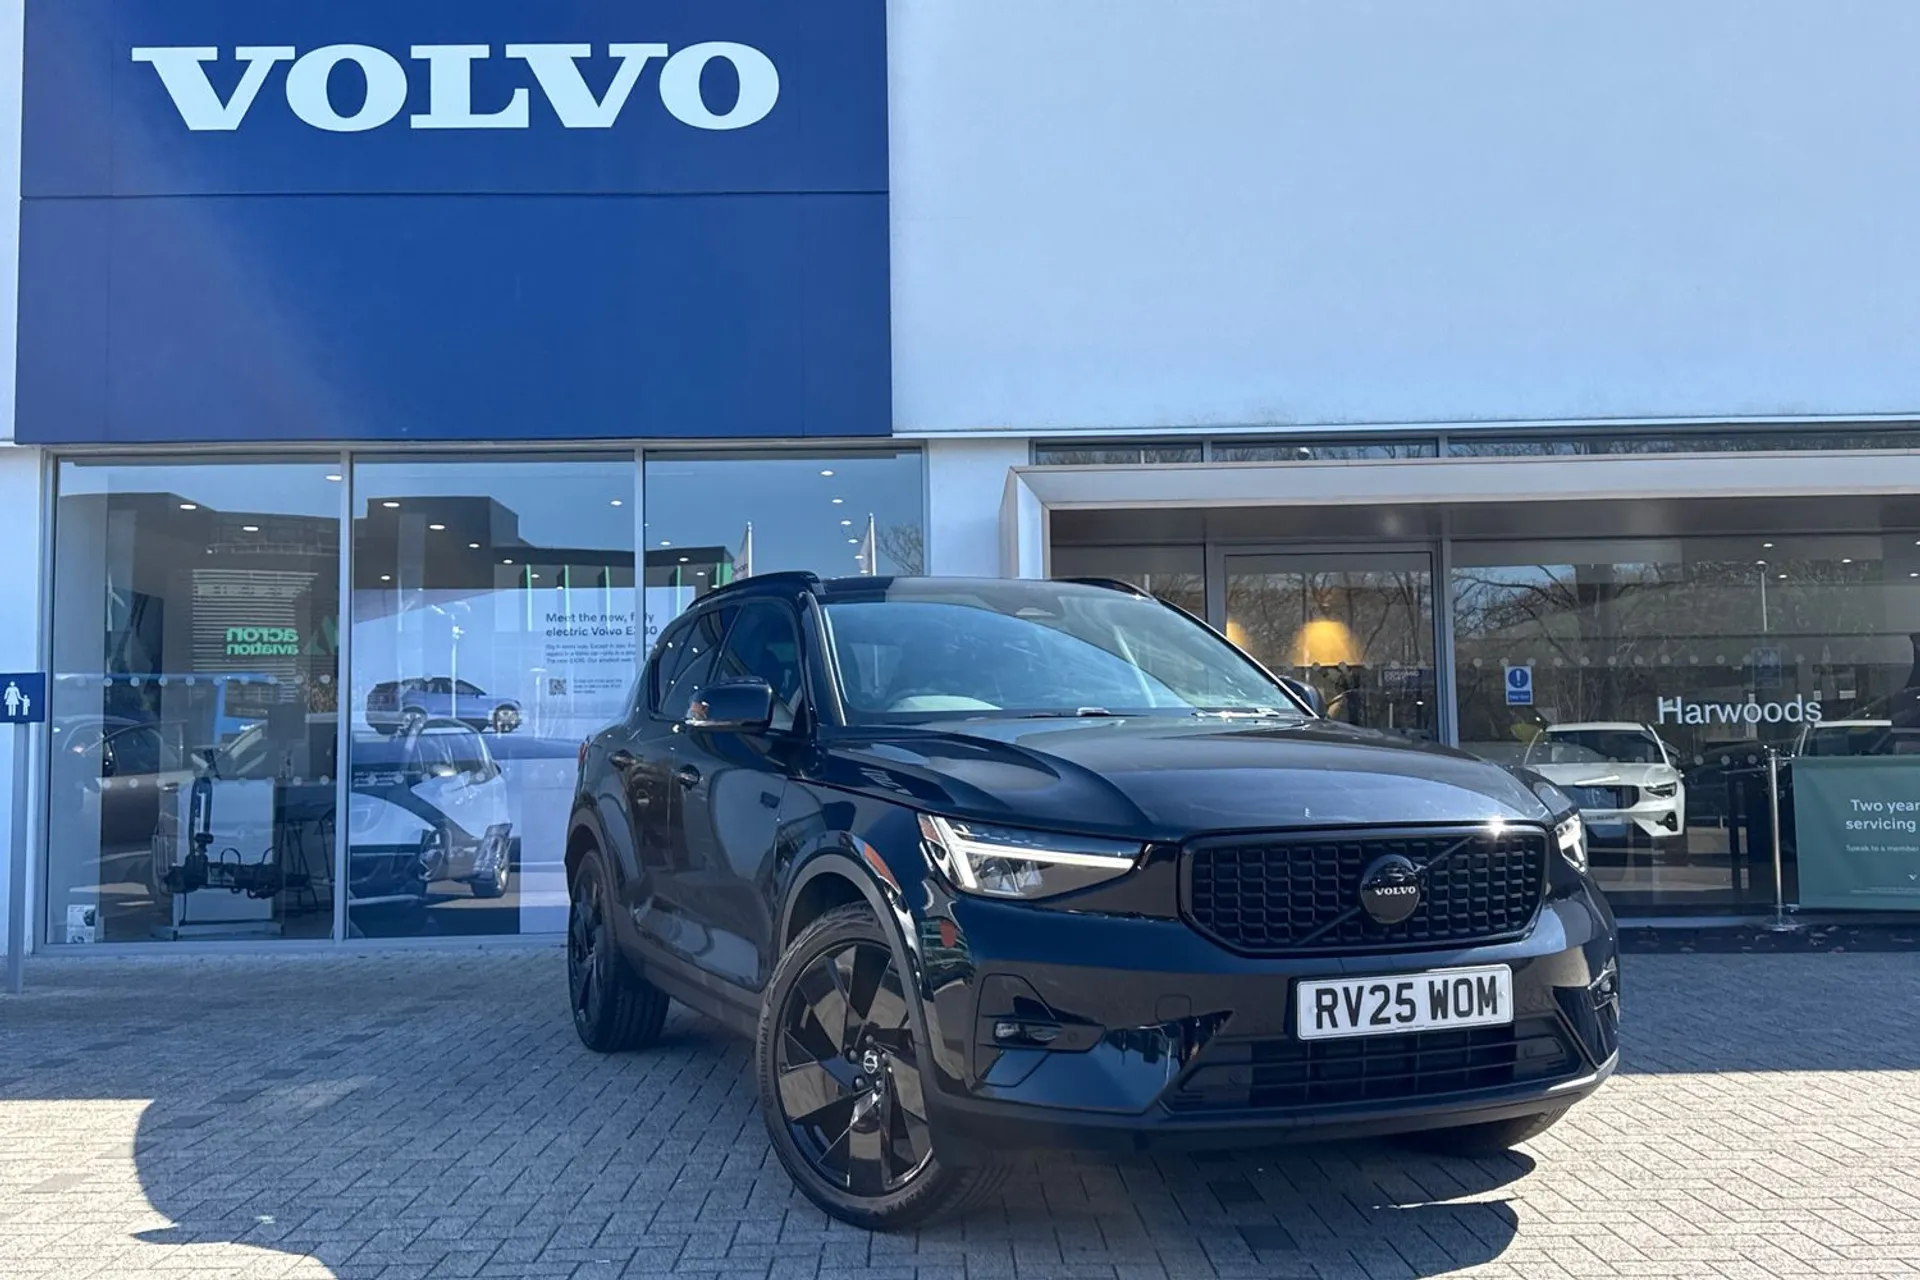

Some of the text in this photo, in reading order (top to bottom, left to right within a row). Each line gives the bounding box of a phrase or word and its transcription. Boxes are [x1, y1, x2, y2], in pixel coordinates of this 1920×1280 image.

[131, 41, 779, 132] VOLVO
[579, 613, 597, 622] the
[546, 627, 588, 636] electric
[591, 626, 622, 636] Volvo
[1657, 693, 1822, 724] Harwoods
[1850, 800, 1883, 811] Two
[1846, 817, 1916, 832] servicing
[1375, 886, 1416, 896] VOLVO
[1315, 975, 1498, 1029] RV25 WOM
